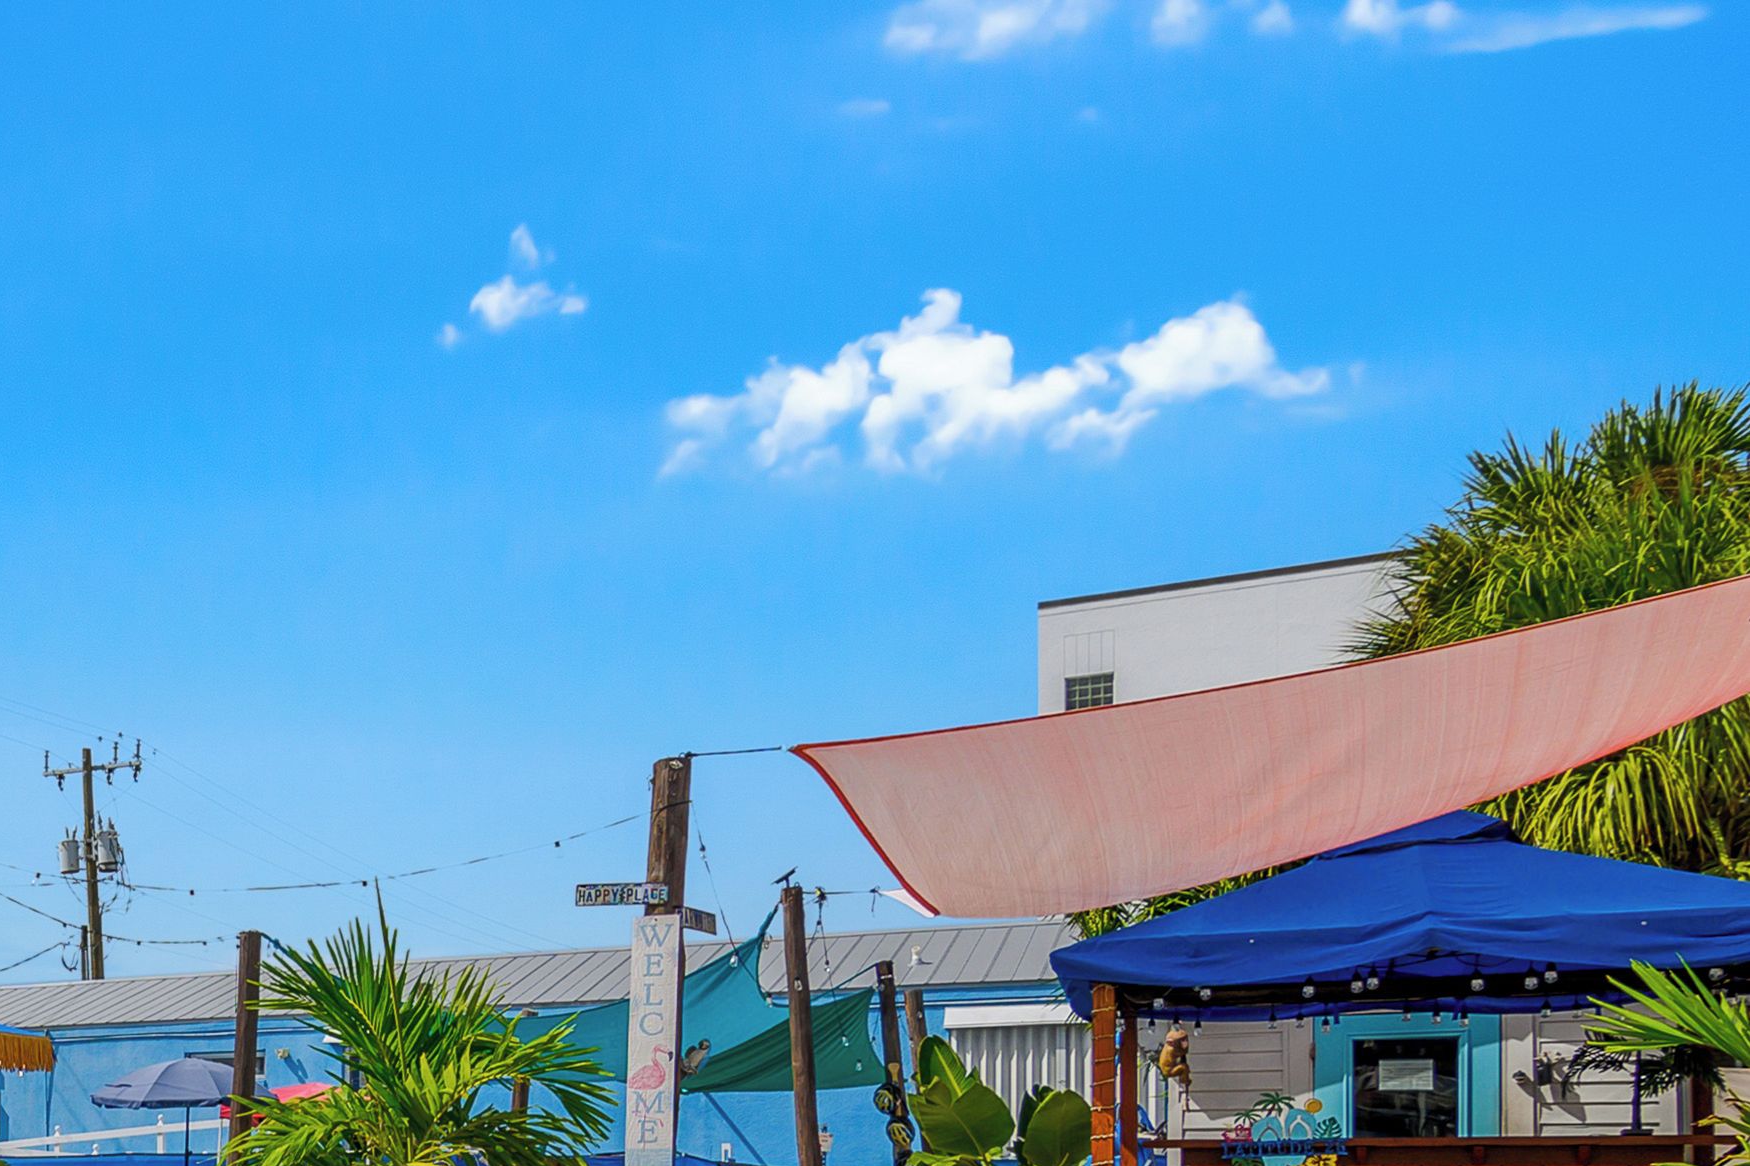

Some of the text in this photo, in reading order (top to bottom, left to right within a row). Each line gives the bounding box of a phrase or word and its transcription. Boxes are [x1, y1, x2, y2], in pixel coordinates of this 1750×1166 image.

[578, 887, 666, 903] HAPPY PLACE
[631, 923, 674, 1145] WELCME
[1221, 1138, 1315, 1159] LATITUDE
